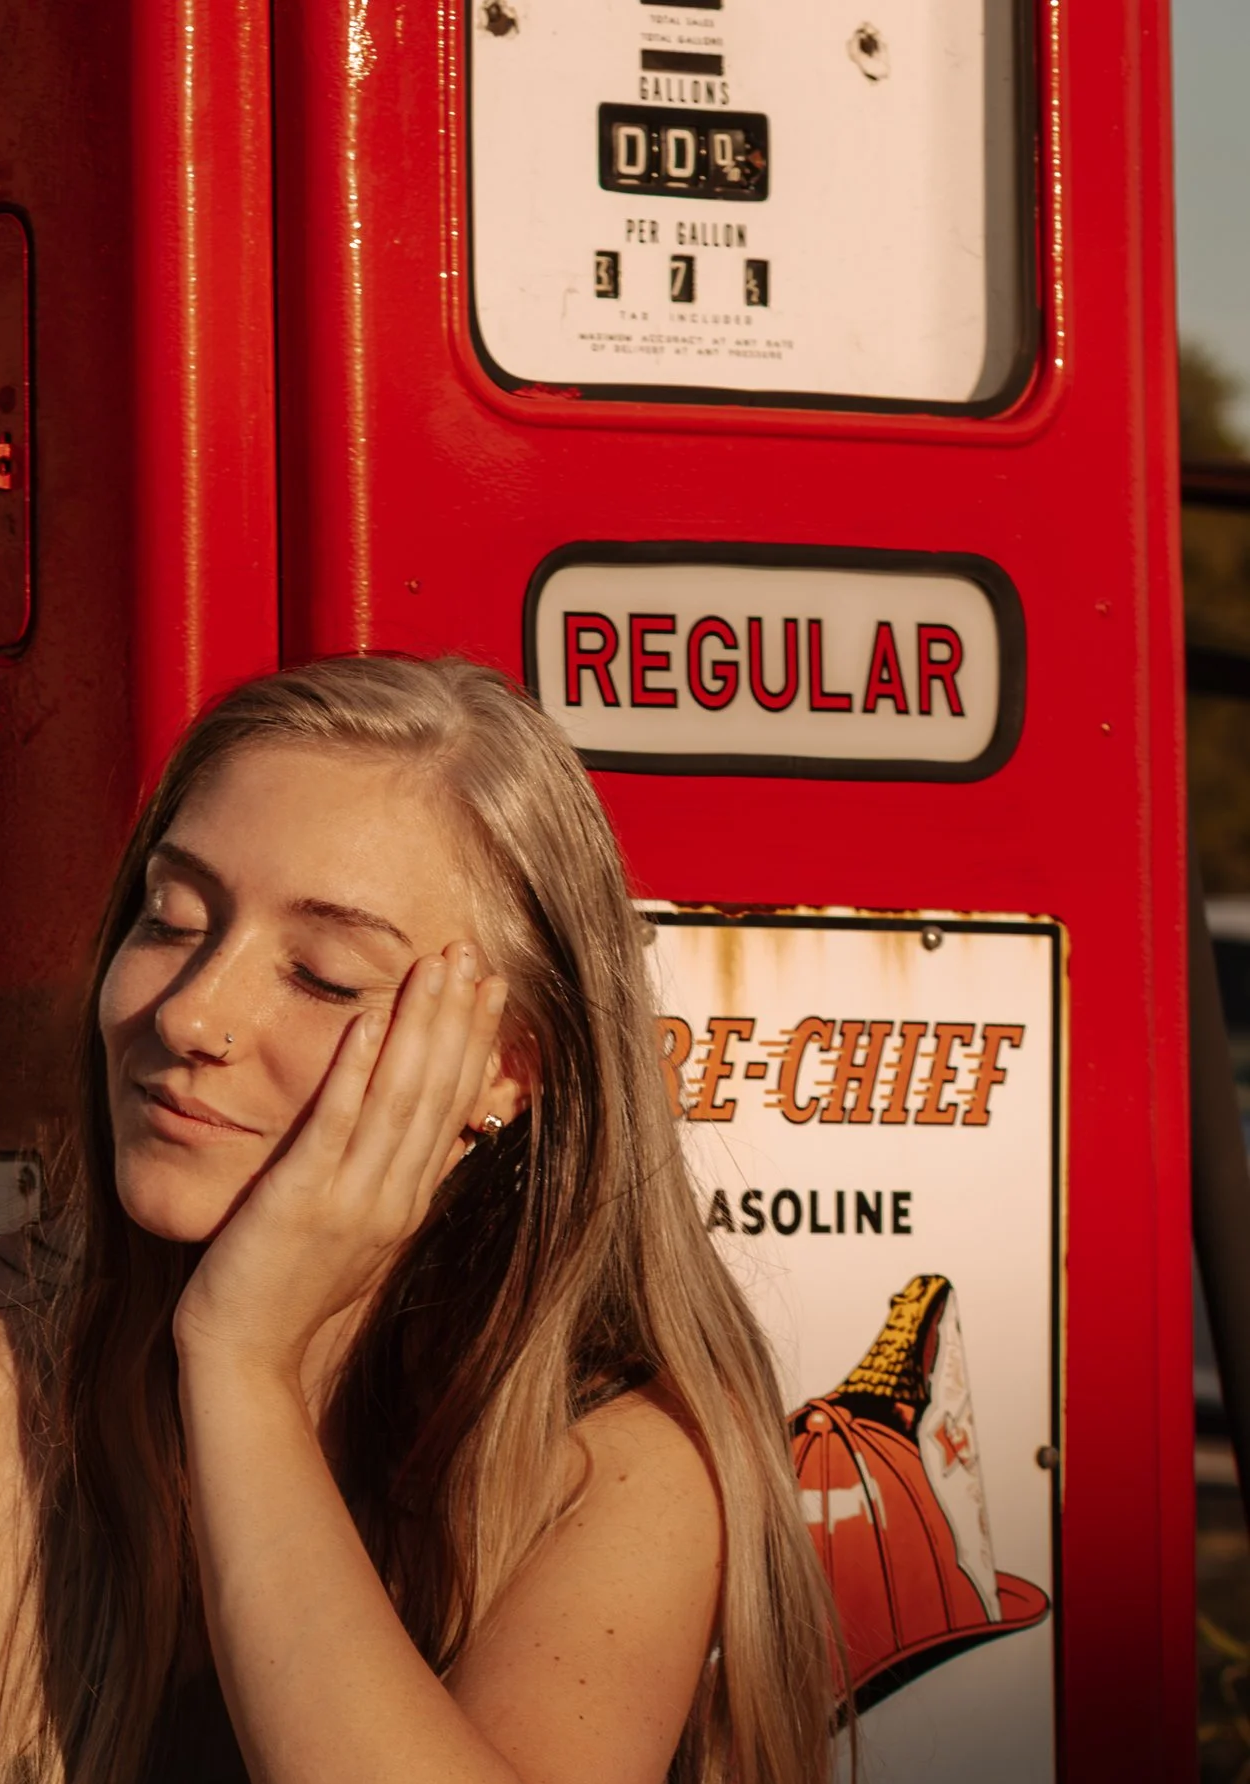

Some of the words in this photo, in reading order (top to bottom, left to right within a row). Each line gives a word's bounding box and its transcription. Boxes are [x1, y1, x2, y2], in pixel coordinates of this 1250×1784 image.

[639, 75, 730, 105] GALLONS
[625, 218, 659, 244] PER
[676, 221, 747, 248] GALLON
[668, 312, 753, 326] INCLUDED
[563, 611, 967, 718] REGULAR
[653, 1015, 1026, 1126] RE-CHIEF
[706, 1187, 912, 1237] ASOLINE
